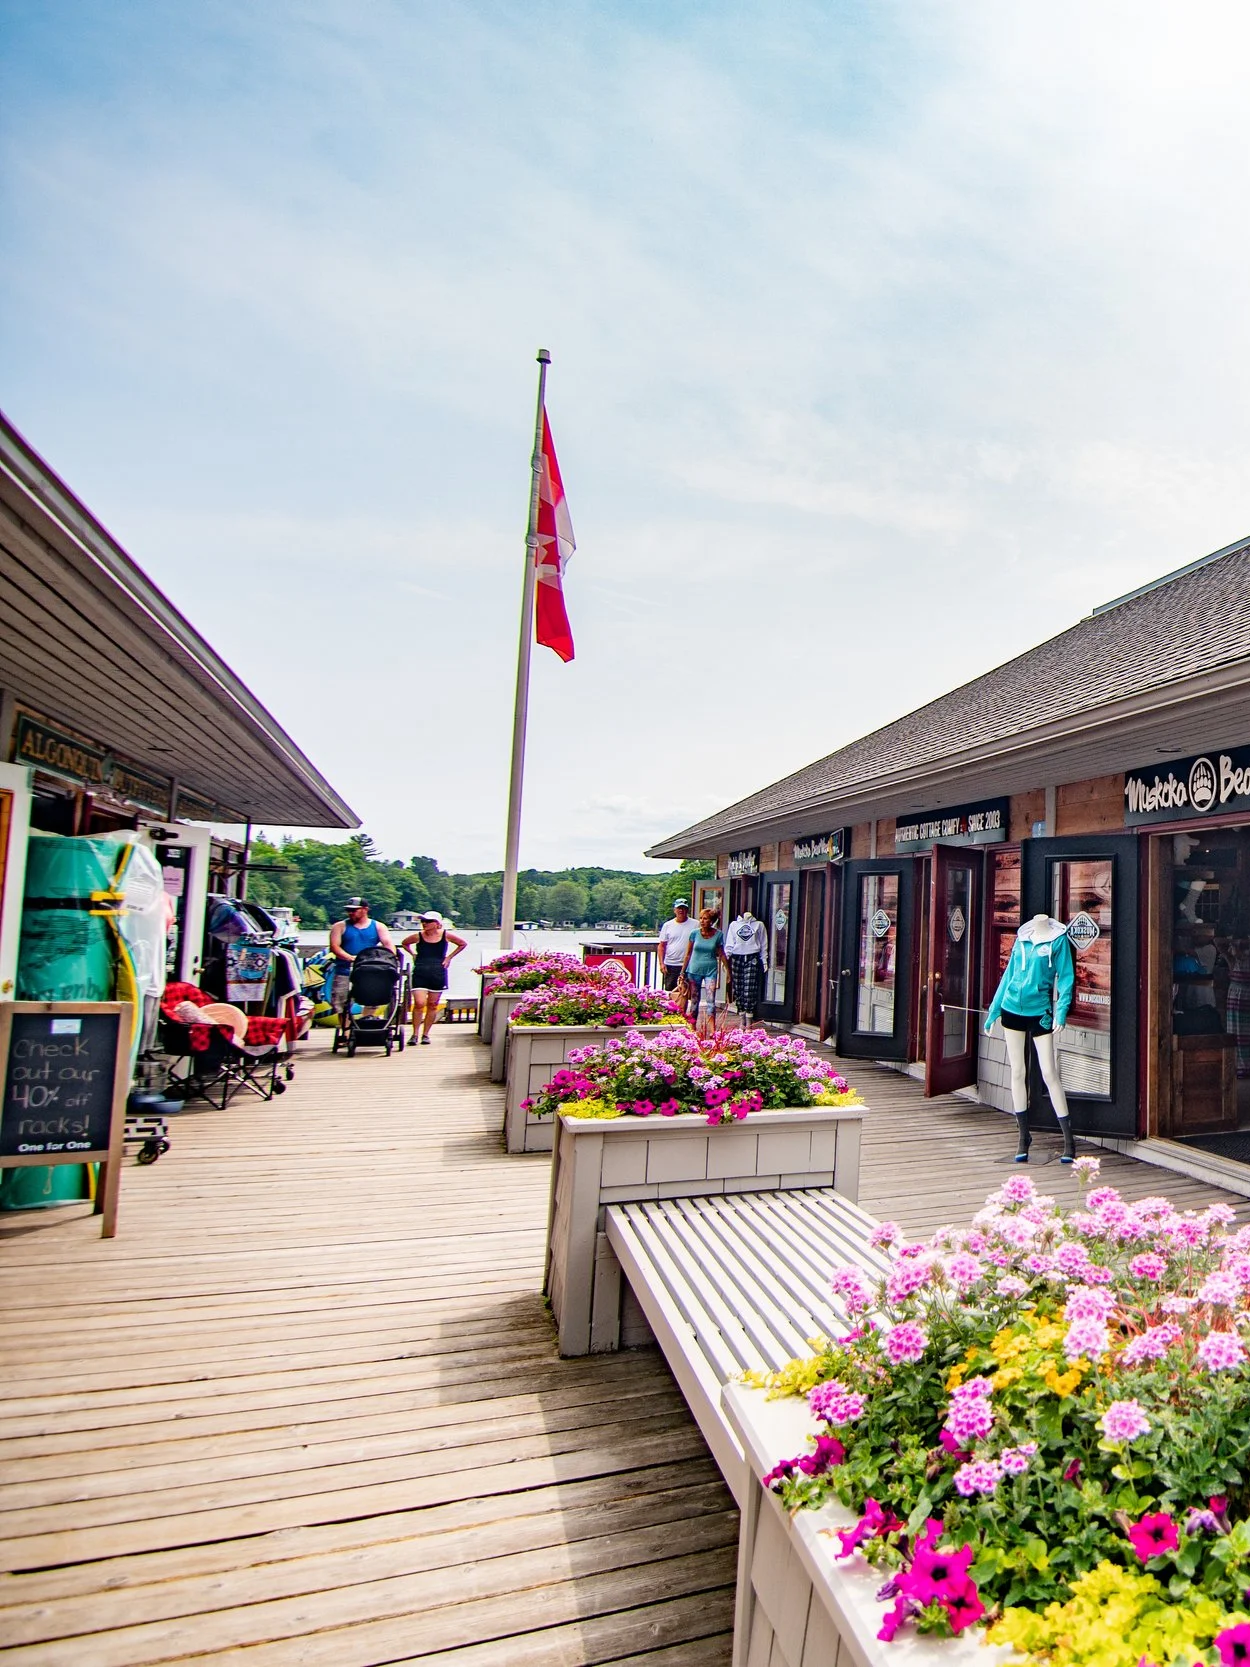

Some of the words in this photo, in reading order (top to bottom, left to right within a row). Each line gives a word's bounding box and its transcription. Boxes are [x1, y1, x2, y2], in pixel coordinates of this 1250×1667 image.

[1125, 773, 1188, 813] Muskoka
[919, 820, 942, 840] COTTAGE
[968, 813, 985, 832] SINCE
[985, 810, 1001, 829] 2003
[13, 1037, 90, 1059] Check
[12, 1061, 53, 1081] out
[58, 1067, 100, 1081] our
[12, 1085, 61, 1109] 40%
[65, 1093, 93, 1107] off
[18, 1114, 90, 1137] racks!
[18, 1143, 44, 1152] One
[46, 1142, 63, 1151] for
[66, 1141, 91, 1150] One
